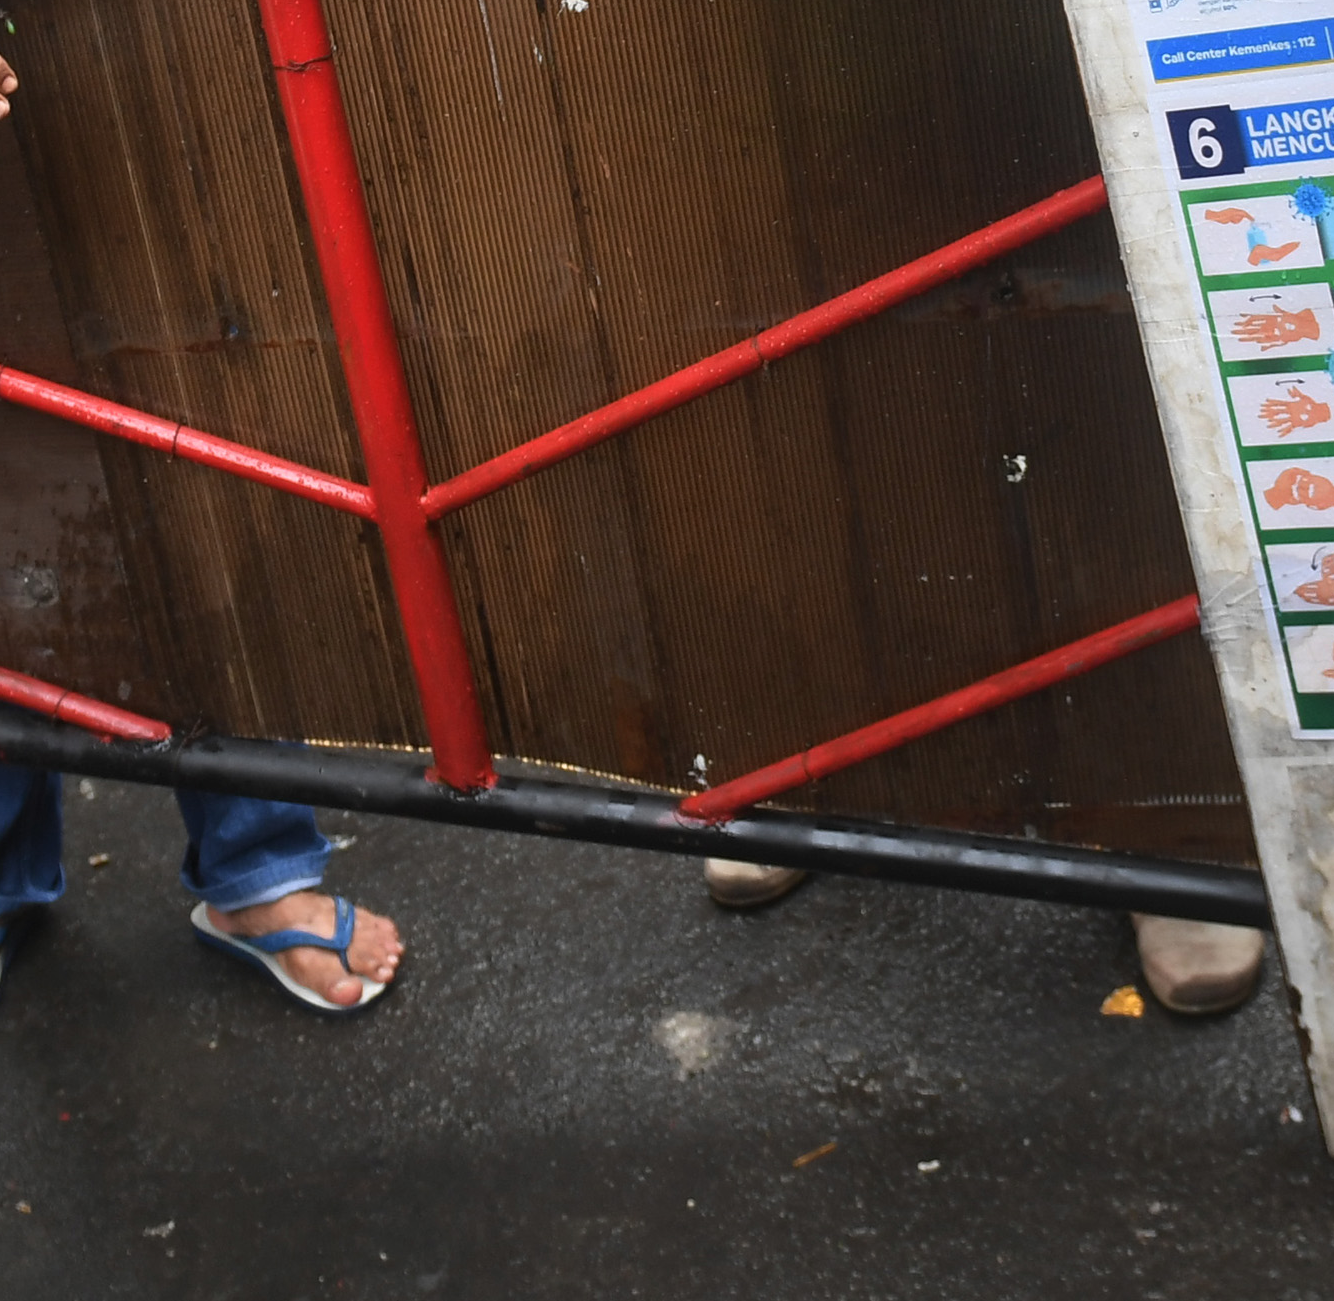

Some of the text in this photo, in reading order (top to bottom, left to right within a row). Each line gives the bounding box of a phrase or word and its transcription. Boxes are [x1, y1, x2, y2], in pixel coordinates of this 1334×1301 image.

[1161, 51, 1186, 65] Call
[1185, 48, 1227, 62] Center
[1228, 40, 1292, 57] Kemenkes
[1297, 35, 1316, 48] 112
[1188, 117, 1223, 169] 6
